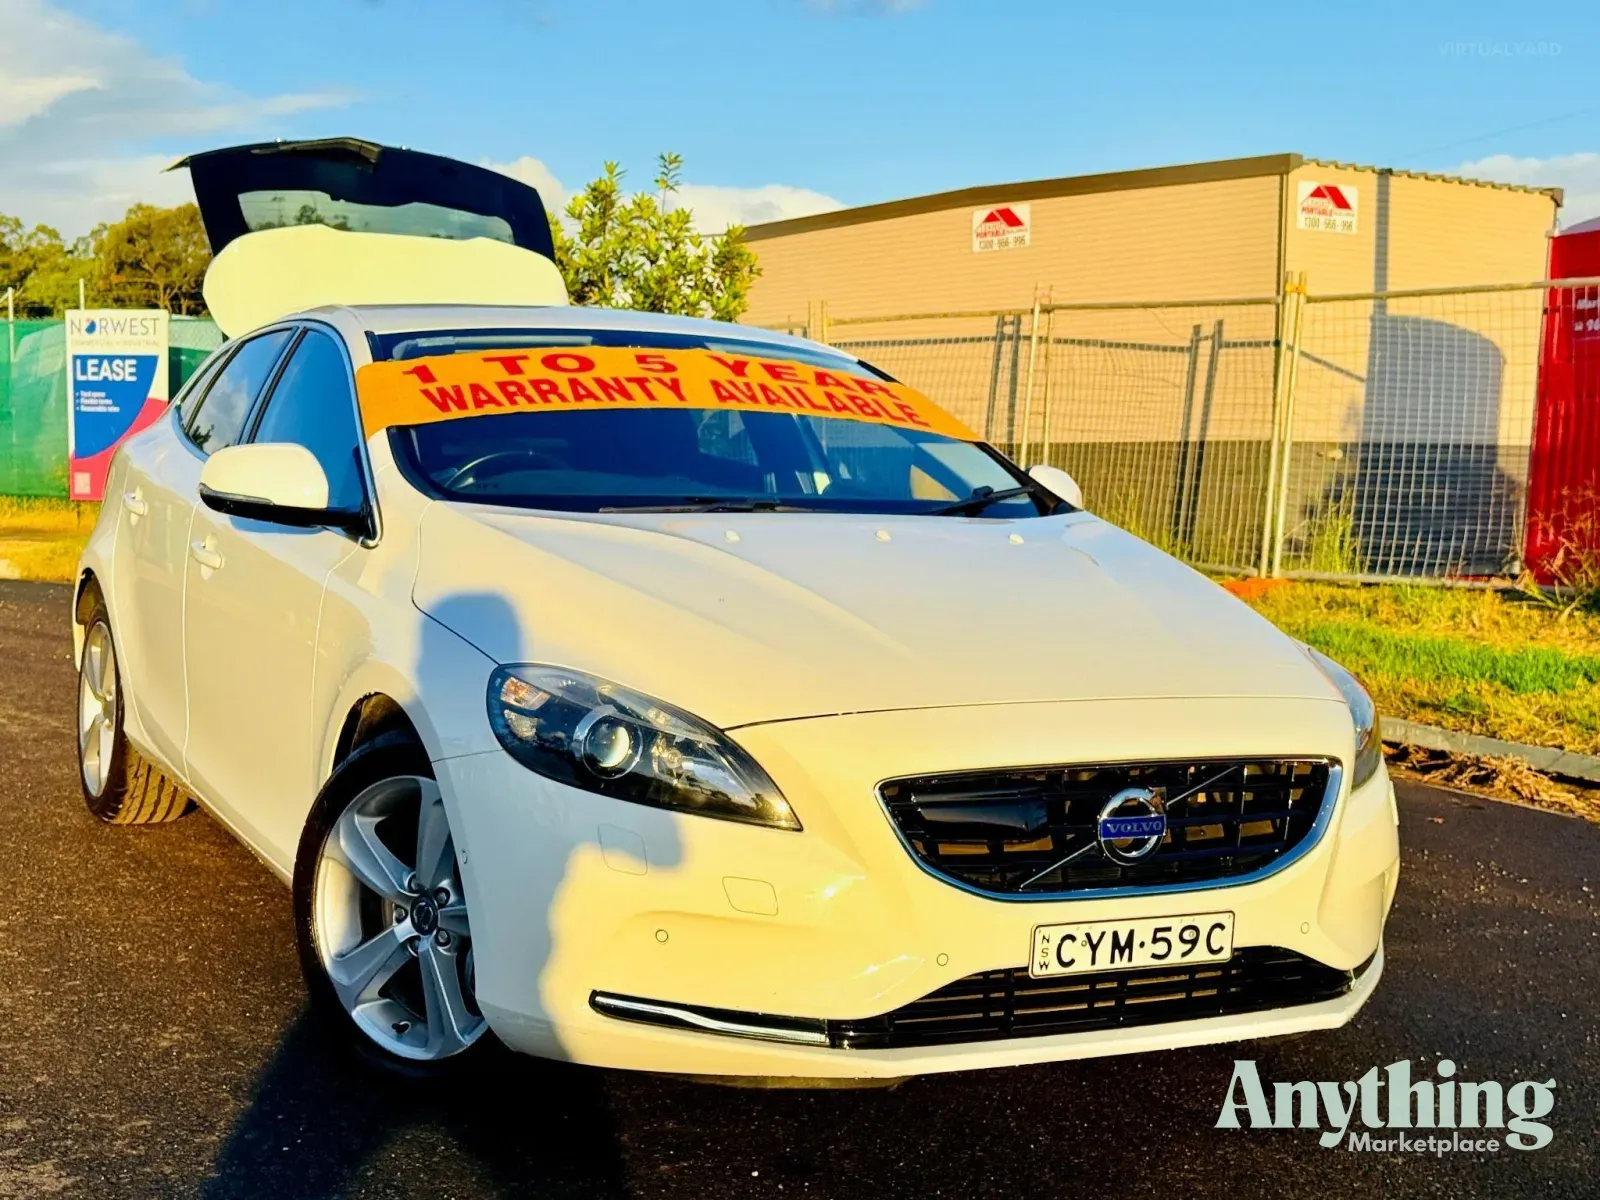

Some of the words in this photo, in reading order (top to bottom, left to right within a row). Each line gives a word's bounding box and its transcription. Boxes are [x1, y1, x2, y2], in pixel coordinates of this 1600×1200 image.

[71, 317, 160, 336] NORWEST
[75, 358, 137, 382] LEASE
[402, 364, 438, 383] 1
[483, 353, 594, 375] TO
[634, 354, 678, 374] 5
[705, 354, 904, 400] YEAR
[420, 376, 687, 413] WARRANTY
[711, 379, 931, 427] AVAILABLE
[1108, 820, 1163, 834] VOLVO
